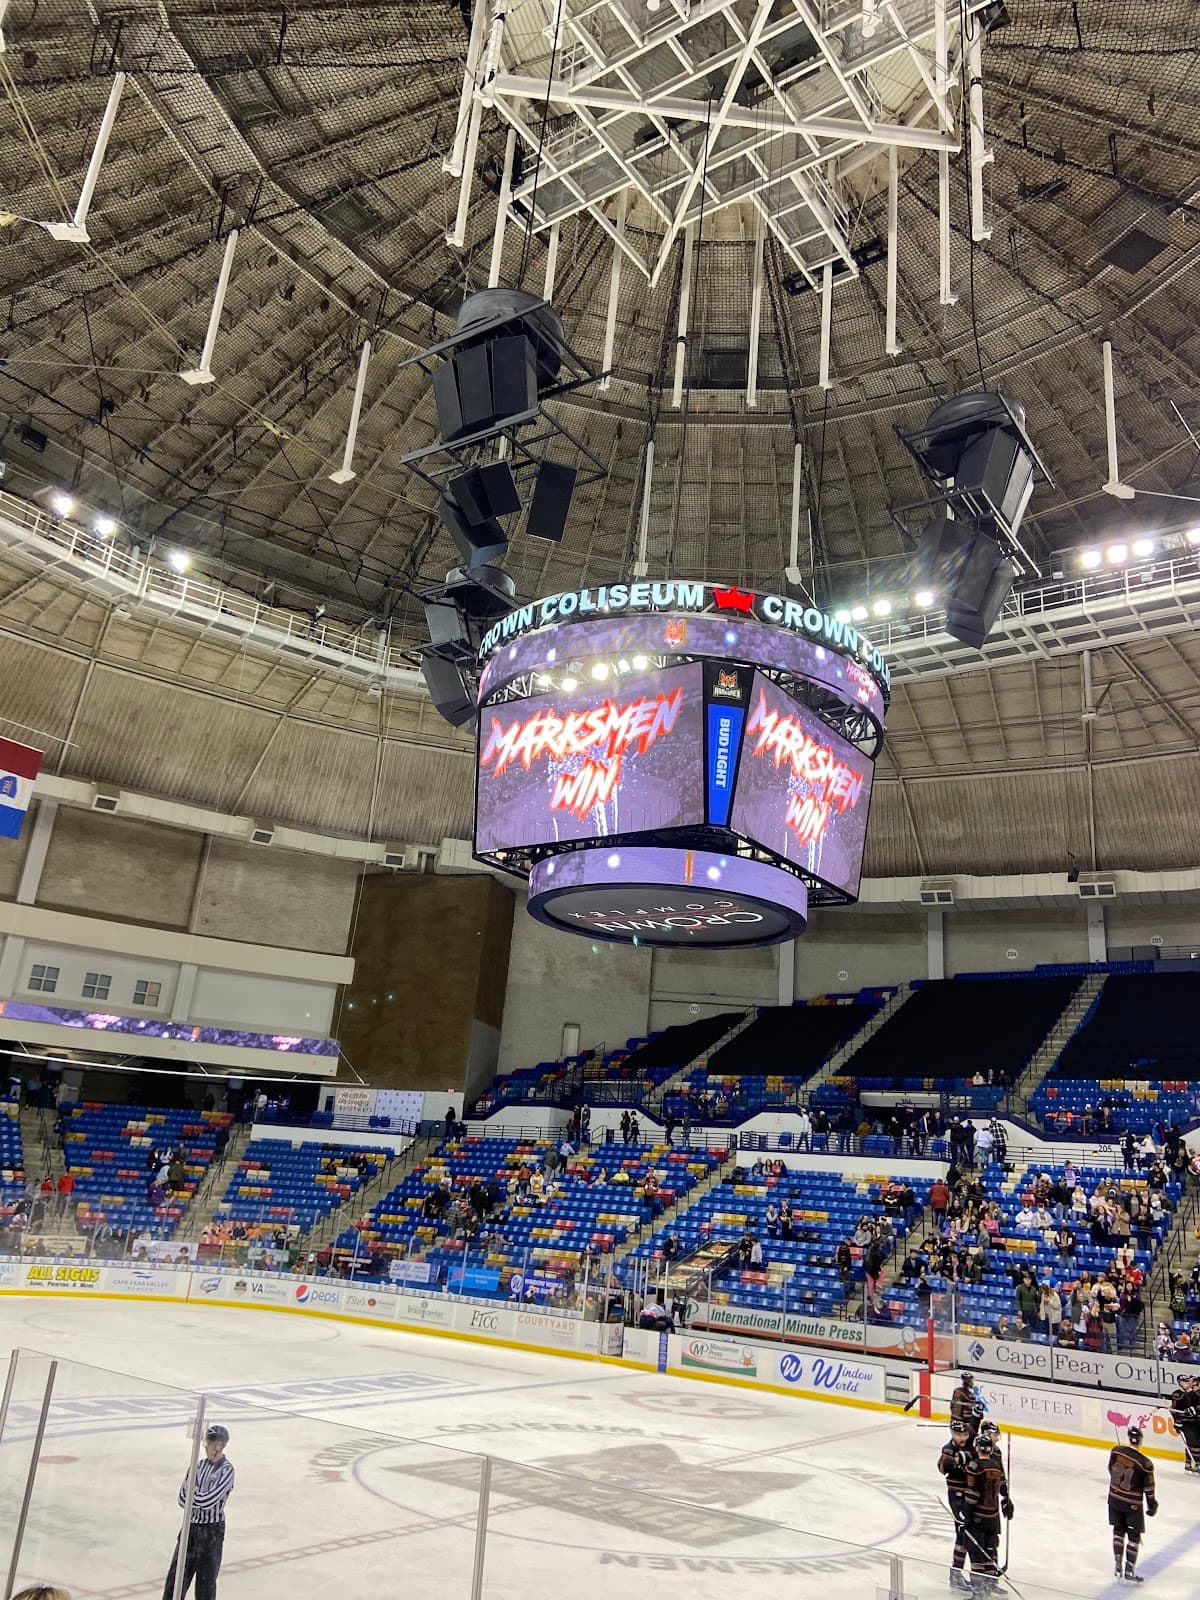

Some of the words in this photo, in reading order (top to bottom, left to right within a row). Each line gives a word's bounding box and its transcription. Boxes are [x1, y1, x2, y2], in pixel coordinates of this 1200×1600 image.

[479, 605, 535, 659] CROWN
[541, 584, 704, 619] COLISEUM
[762, 596, 858, 651] CROWN
[480, 687, 683, 777] MARKSMEN
[718, 718, 731, 748] BUD
[747, 688, 864, 815] MARKSMEN
[715, 749, 729, 788] LIGHT
[550, 754, 623, 821] WIN
[785, 792, 830, 847] WIN
[568, 901, 734, 919] COMPLEX
[591, 911, 764, 932] CROWN
[1098, 1144, 1113, 1153] 205
[27, 1266, 54, 1281] ALL
[56, 1266, 99, 1283] SIGNS
[252, 1282, 264, 1294] VA
[311, 1289, 339, 1305] pepsi
[470, 1310, 499, 1330] FTCC
[518, 1314, 575, 1331] COURTYARD
[711, 1308, 781, 1330] International
[785, 1319, 826, 1337] Minute
[828, 1324, 863, 1342] Press
[996, 1345, 1047, 1369] Cape
[1054, 1353, 1104, 1376] Fear
[1114, 1361, 1178, 1385] Orth
[1020, 1395, 1073, 1416] PETER
[1152, 1415, 1180, 1437] DU
